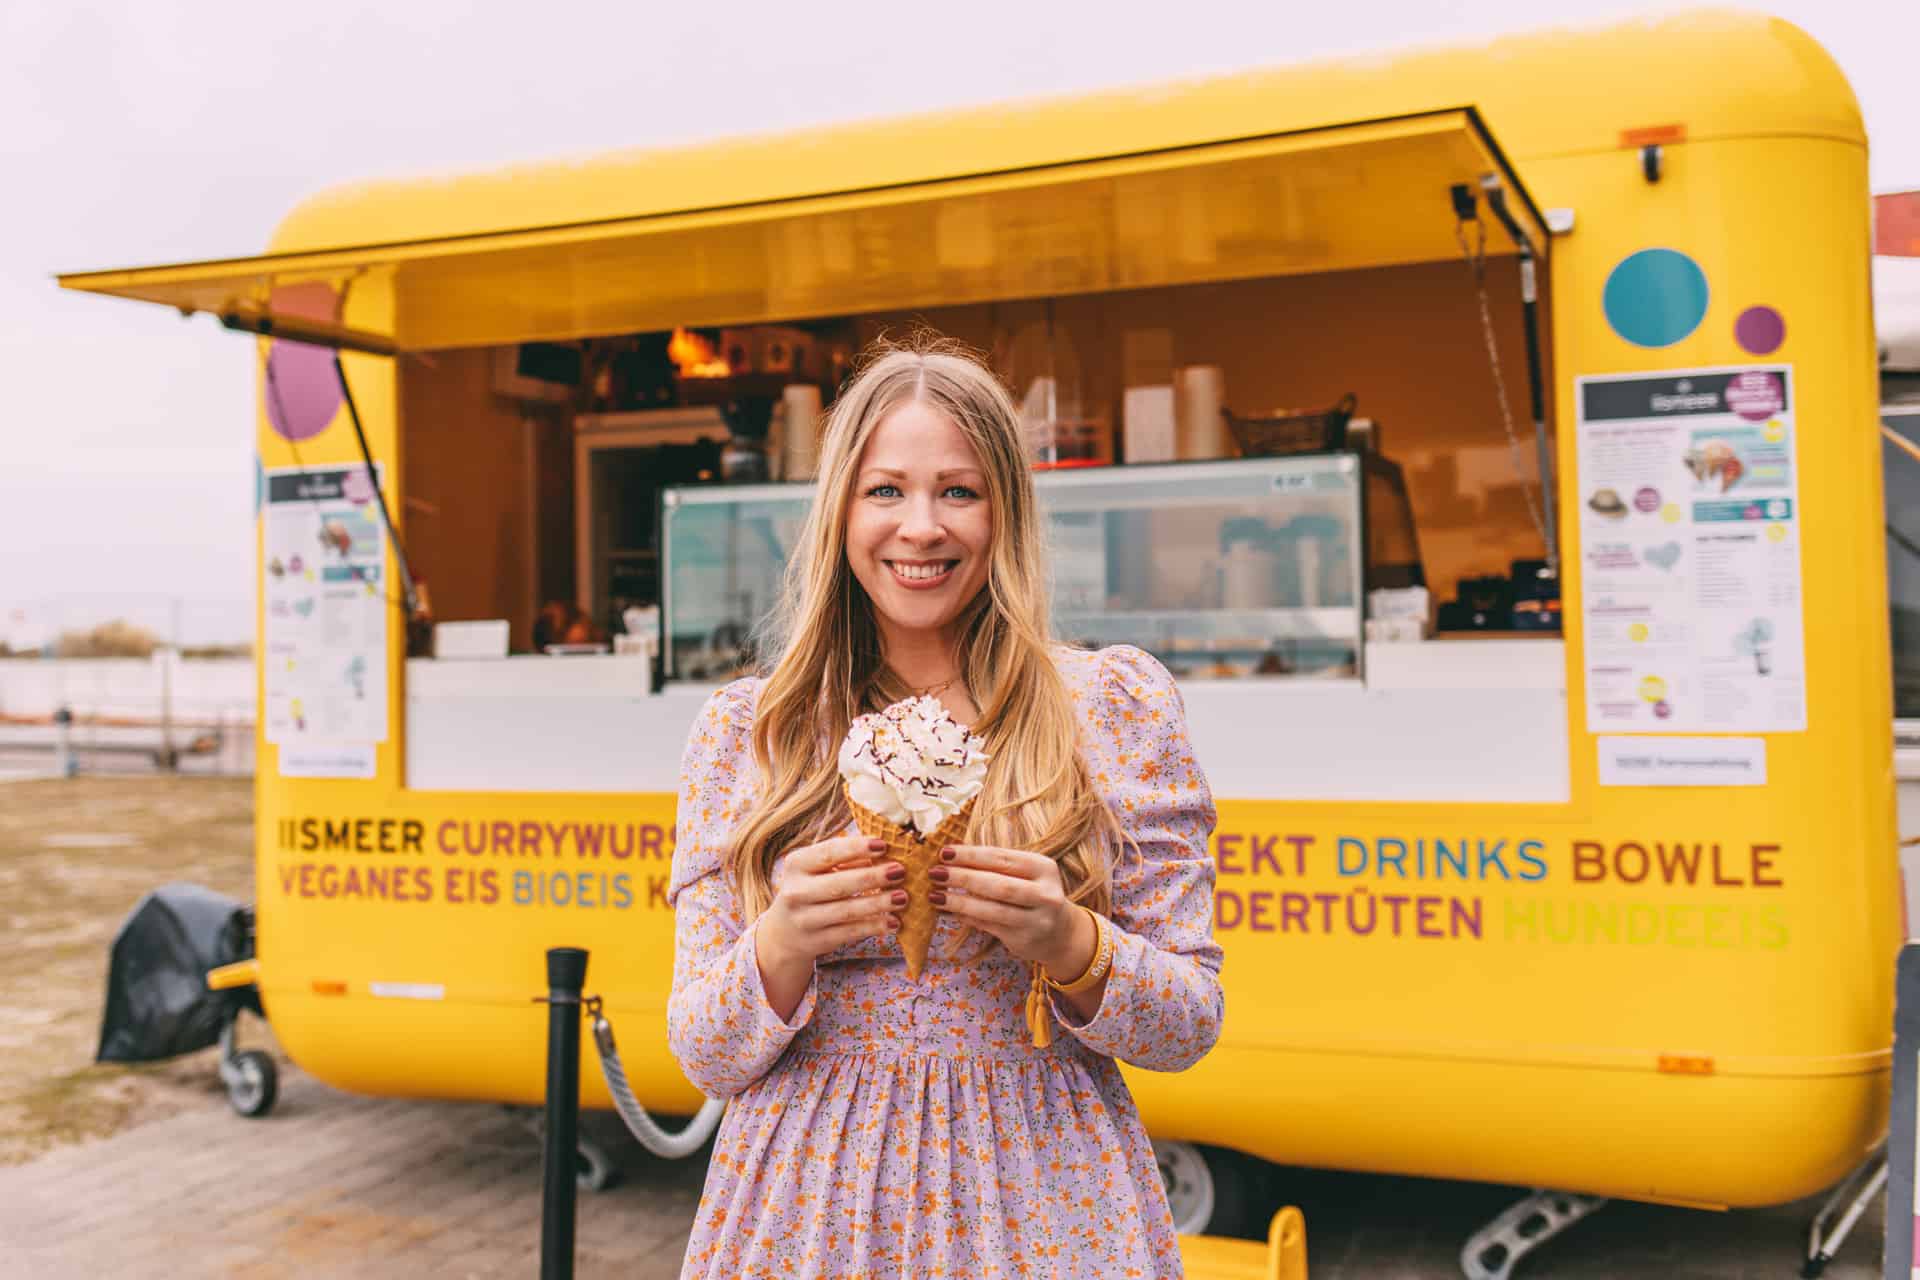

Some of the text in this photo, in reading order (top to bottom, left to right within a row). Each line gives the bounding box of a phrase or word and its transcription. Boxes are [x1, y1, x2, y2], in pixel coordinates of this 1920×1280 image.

[437, 820, 676, 860] CURRYWUR
[1336, 836, 1548, 882] DRINKS
[1571, 840, 1784, 887] BOWLE
[279, 864, 433, 901] VEGANES
[445, 867, 499, 904] EIS
[512, 870, 633, 909] BIOEIS
[1503, 896, 1791, 951] HUNDEEIS
